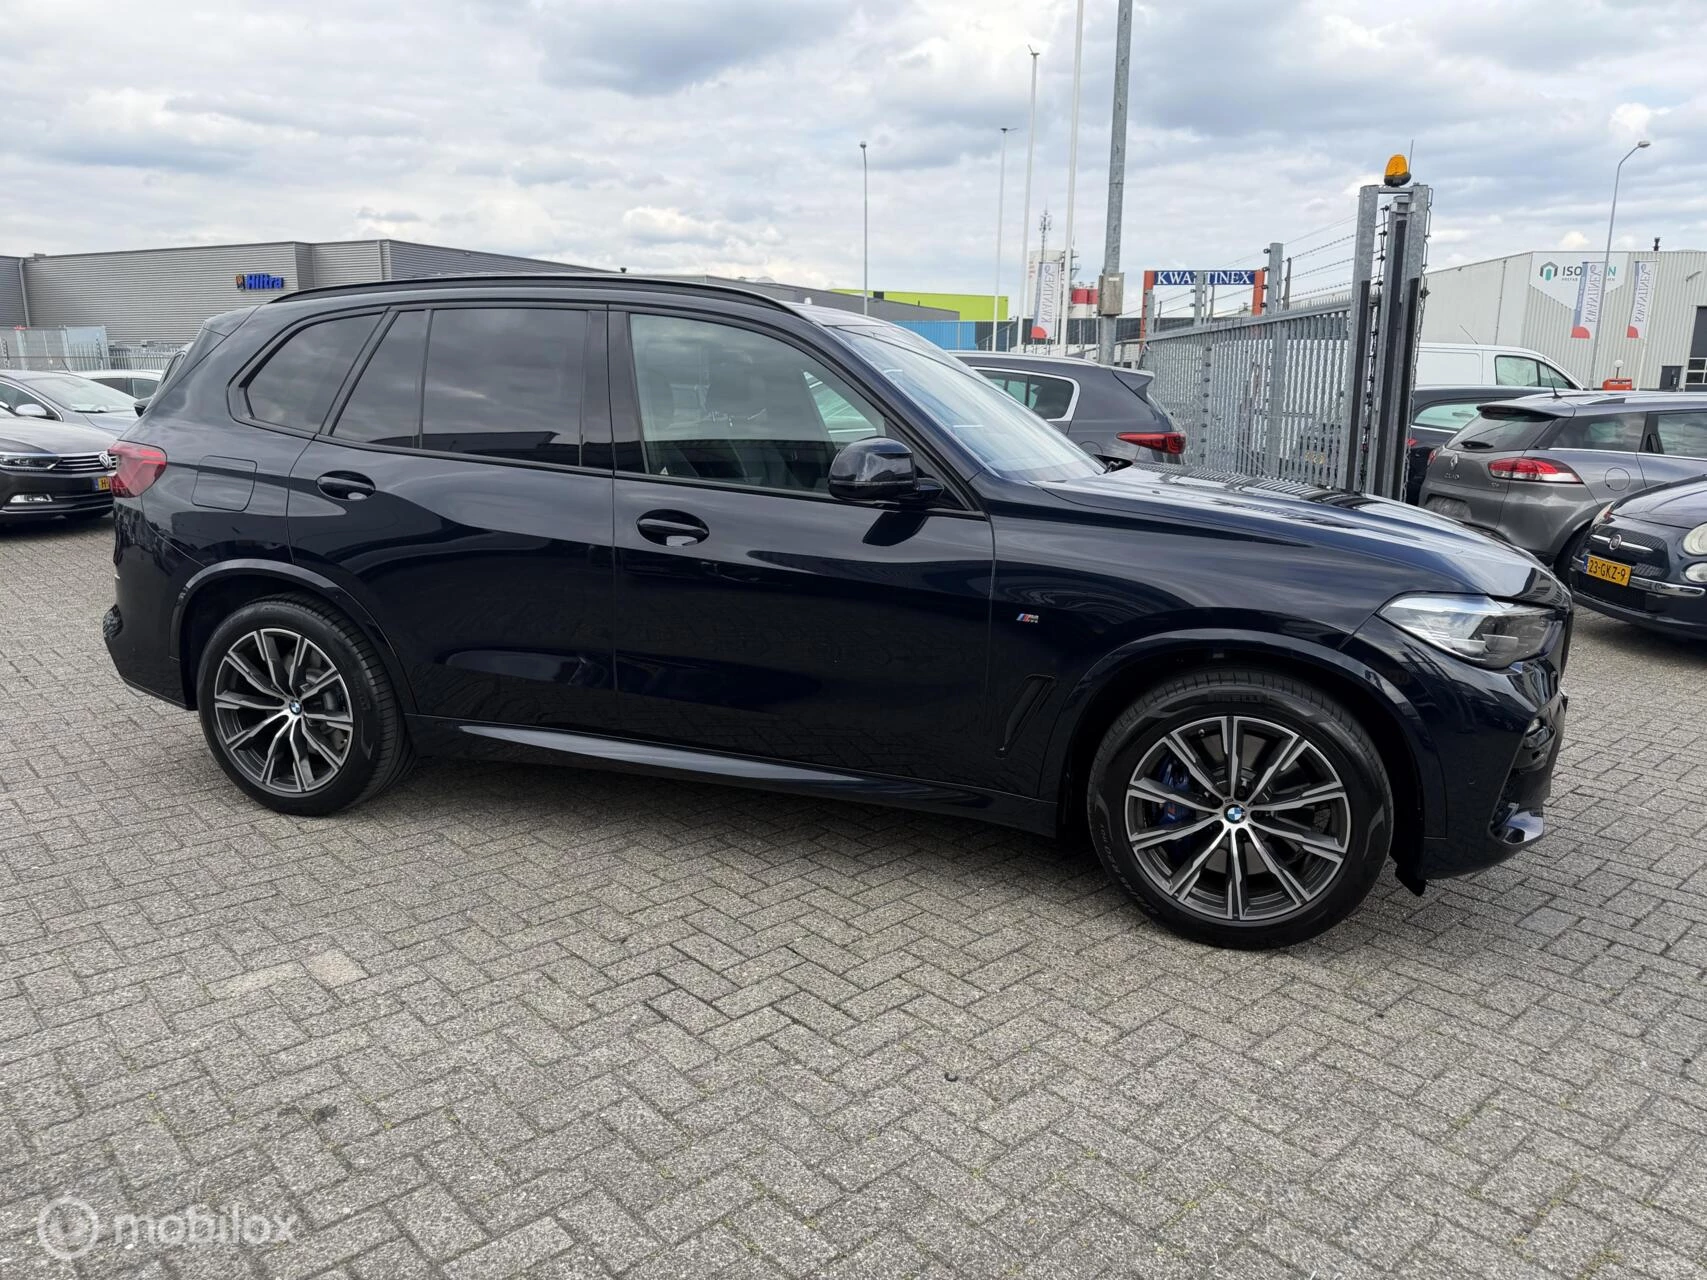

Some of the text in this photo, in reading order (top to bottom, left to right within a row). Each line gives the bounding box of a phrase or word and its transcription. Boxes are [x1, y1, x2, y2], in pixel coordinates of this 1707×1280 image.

[247, 273, 283, 289] Hiltra
[1157, 271, 1253, 285] KWATINEX
[1589, 560, 1627, 582] 23-GKZ-9
